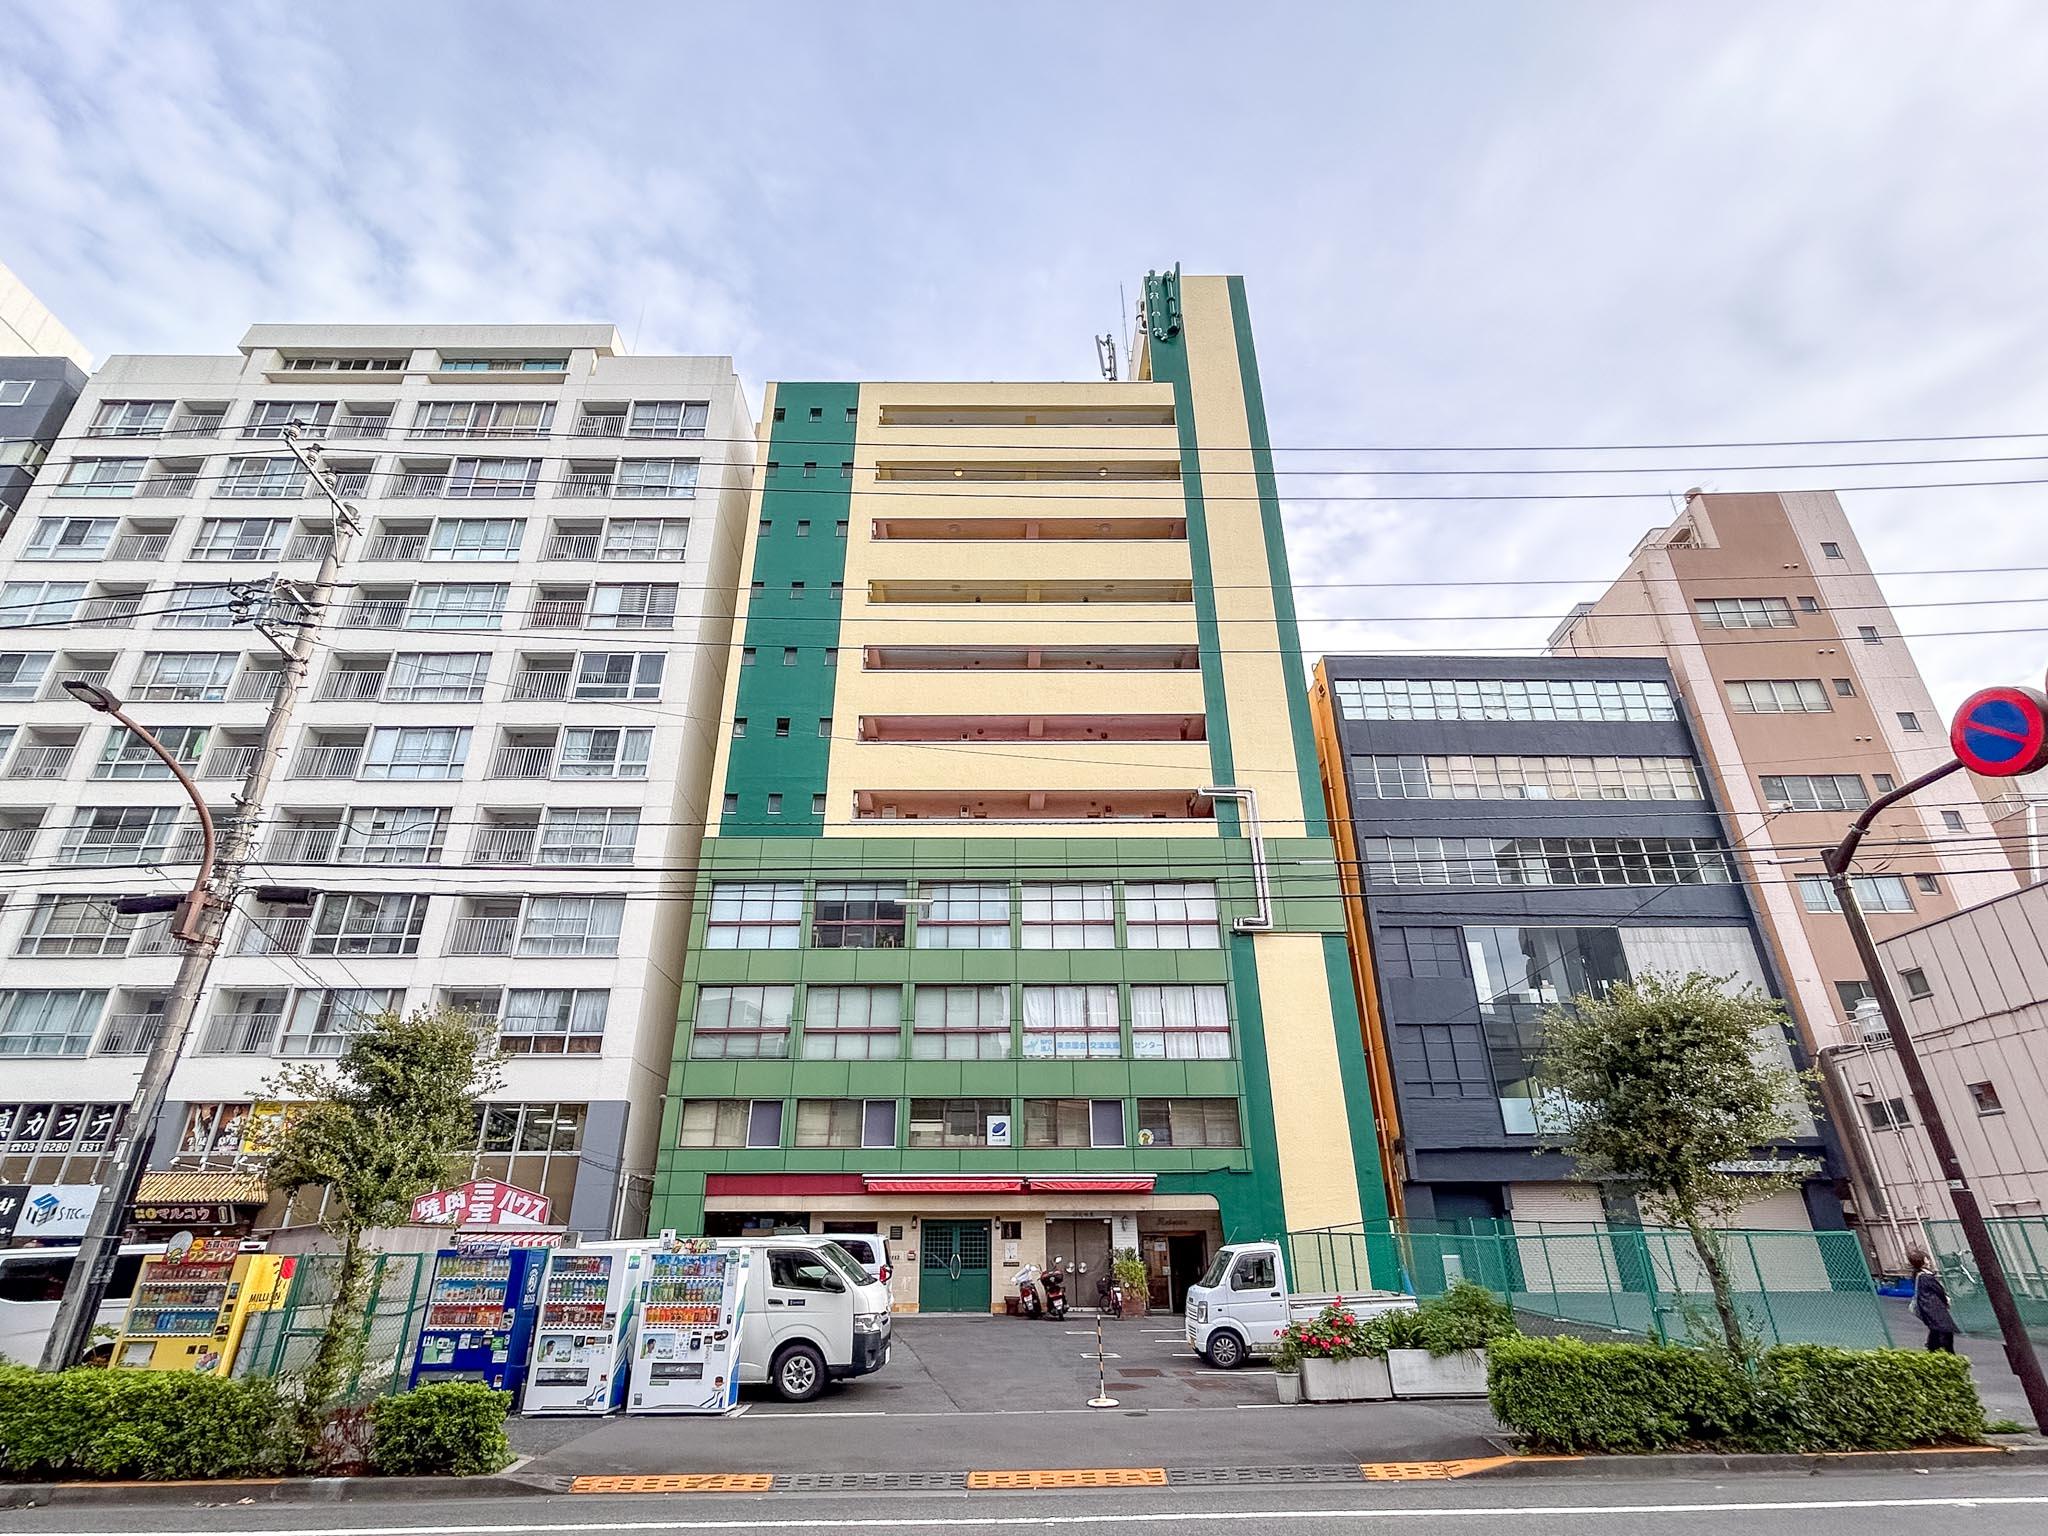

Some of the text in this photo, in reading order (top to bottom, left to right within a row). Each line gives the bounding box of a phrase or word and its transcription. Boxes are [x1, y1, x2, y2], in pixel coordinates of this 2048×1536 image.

[189, 1250, 238, 1263] ワンコイン
[249, 1292, 282, 1303] MILLIN
